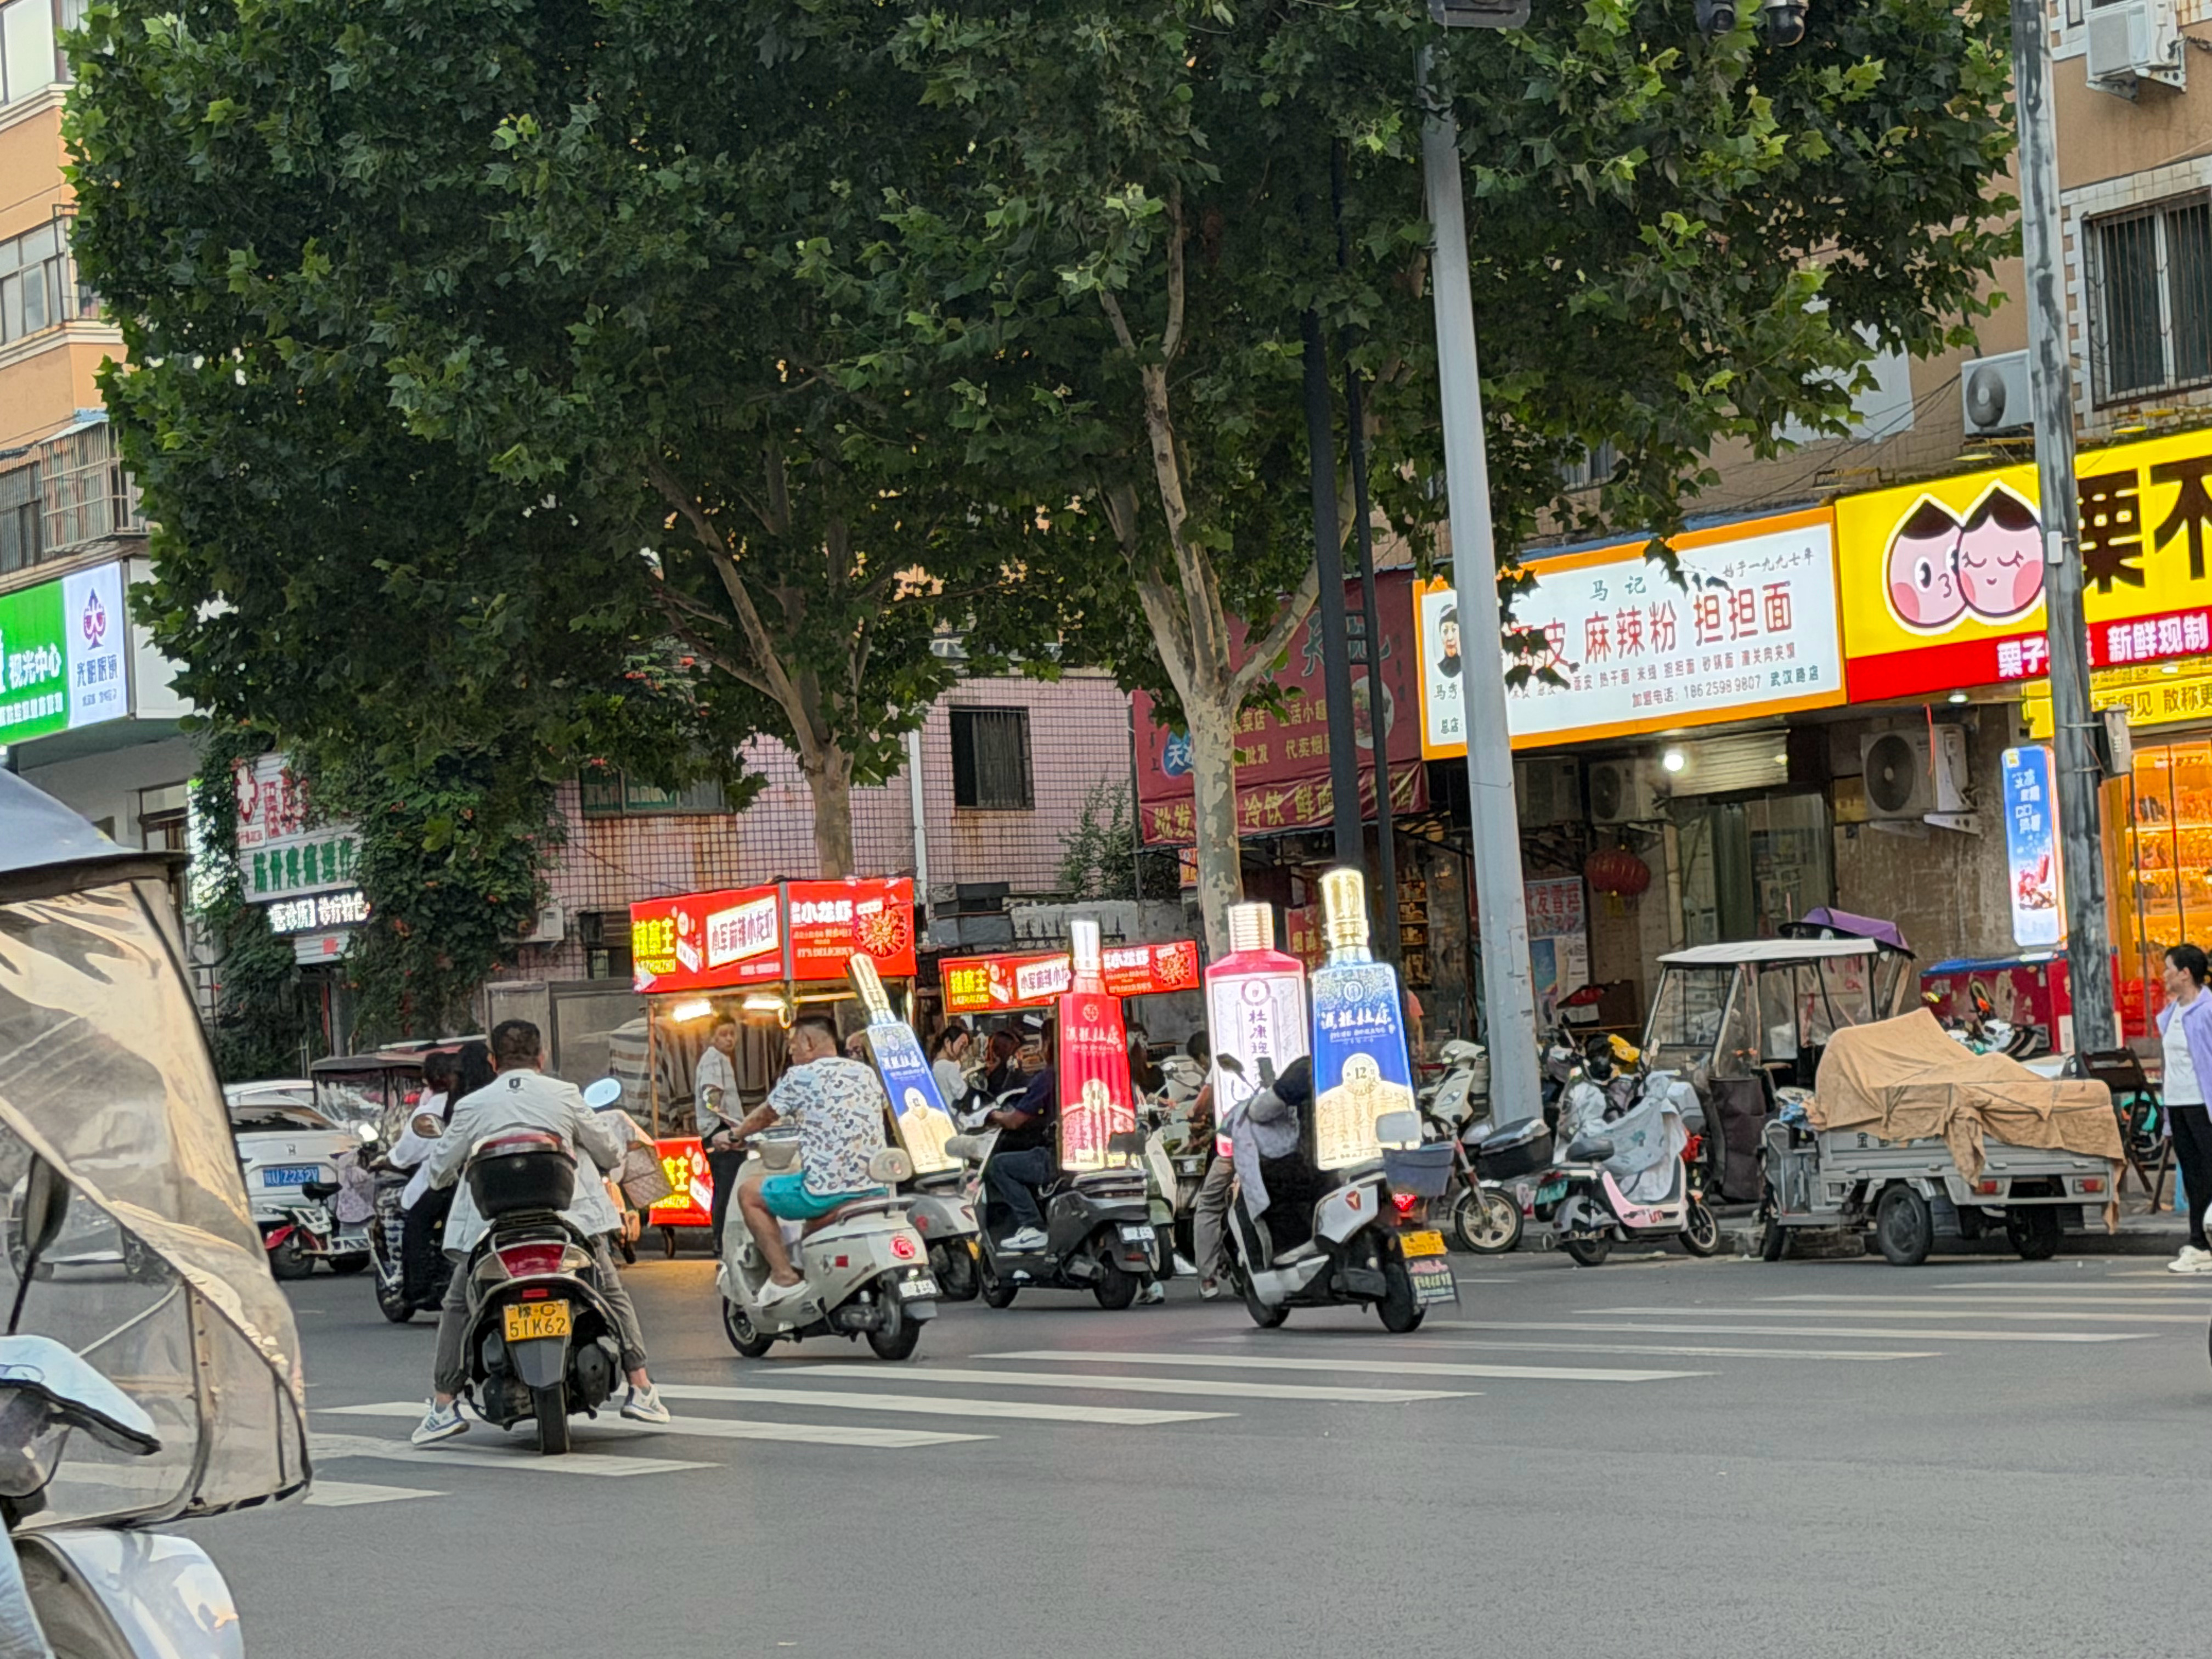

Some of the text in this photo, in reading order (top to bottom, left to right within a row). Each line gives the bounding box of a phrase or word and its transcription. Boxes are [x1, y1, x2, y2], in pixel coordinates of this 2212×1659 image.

[1590, 576, 1646, 602] 马记
[1585, 599, 1677, 664] 麻辣粉
[1694, 580, 1792, 646] 担担面
[2107, 612, 2209, 663] 新鲜现制
[1664, 658, 1695, 678] 担担面
[1244, 790, 1285, 828] 冷饮
[509, 1317, 566, 1338] 51K62
